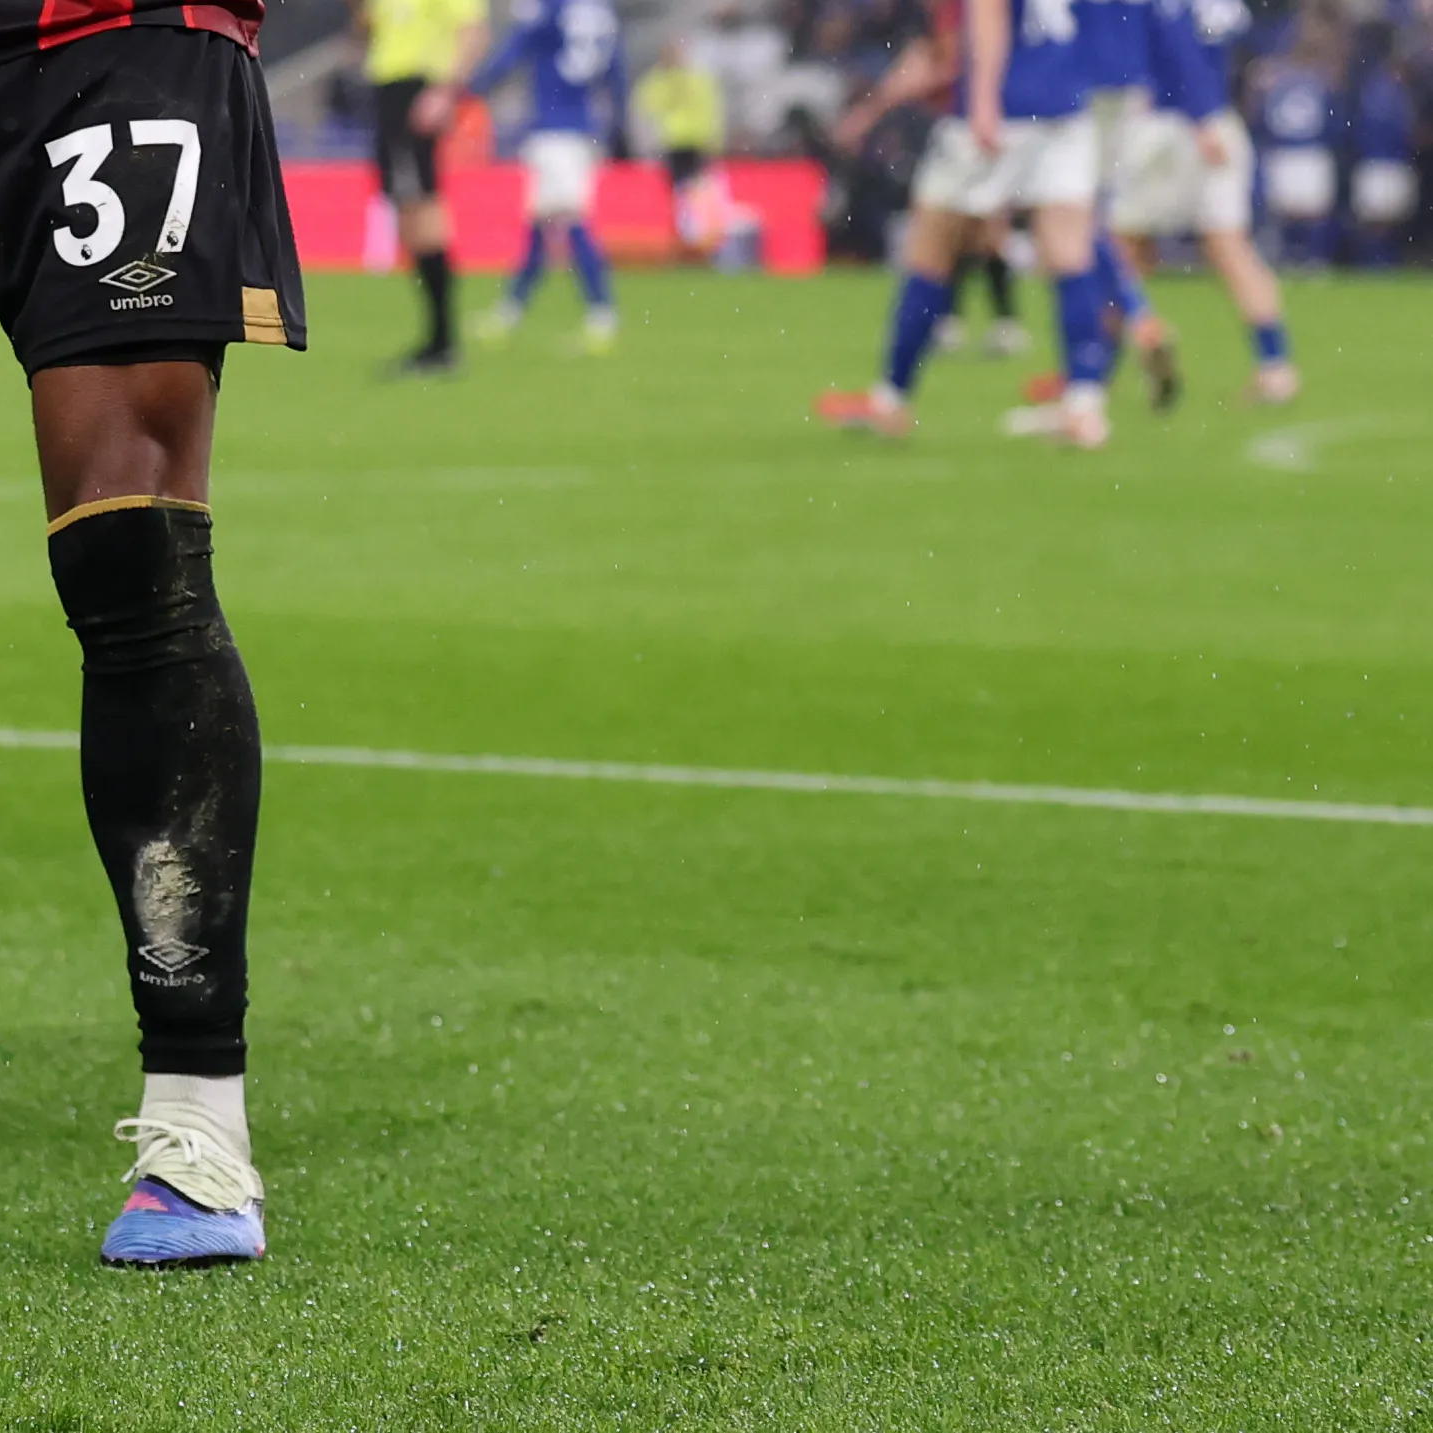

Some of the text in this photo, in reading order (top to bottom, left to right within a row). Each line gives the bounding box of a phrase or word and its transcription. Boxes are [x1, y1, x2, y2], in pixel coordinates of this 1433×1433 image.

[44, 119, 201, 267] 37
[110, 293, 174, 311] umbro
[139, 971, 206, 987] umbro
